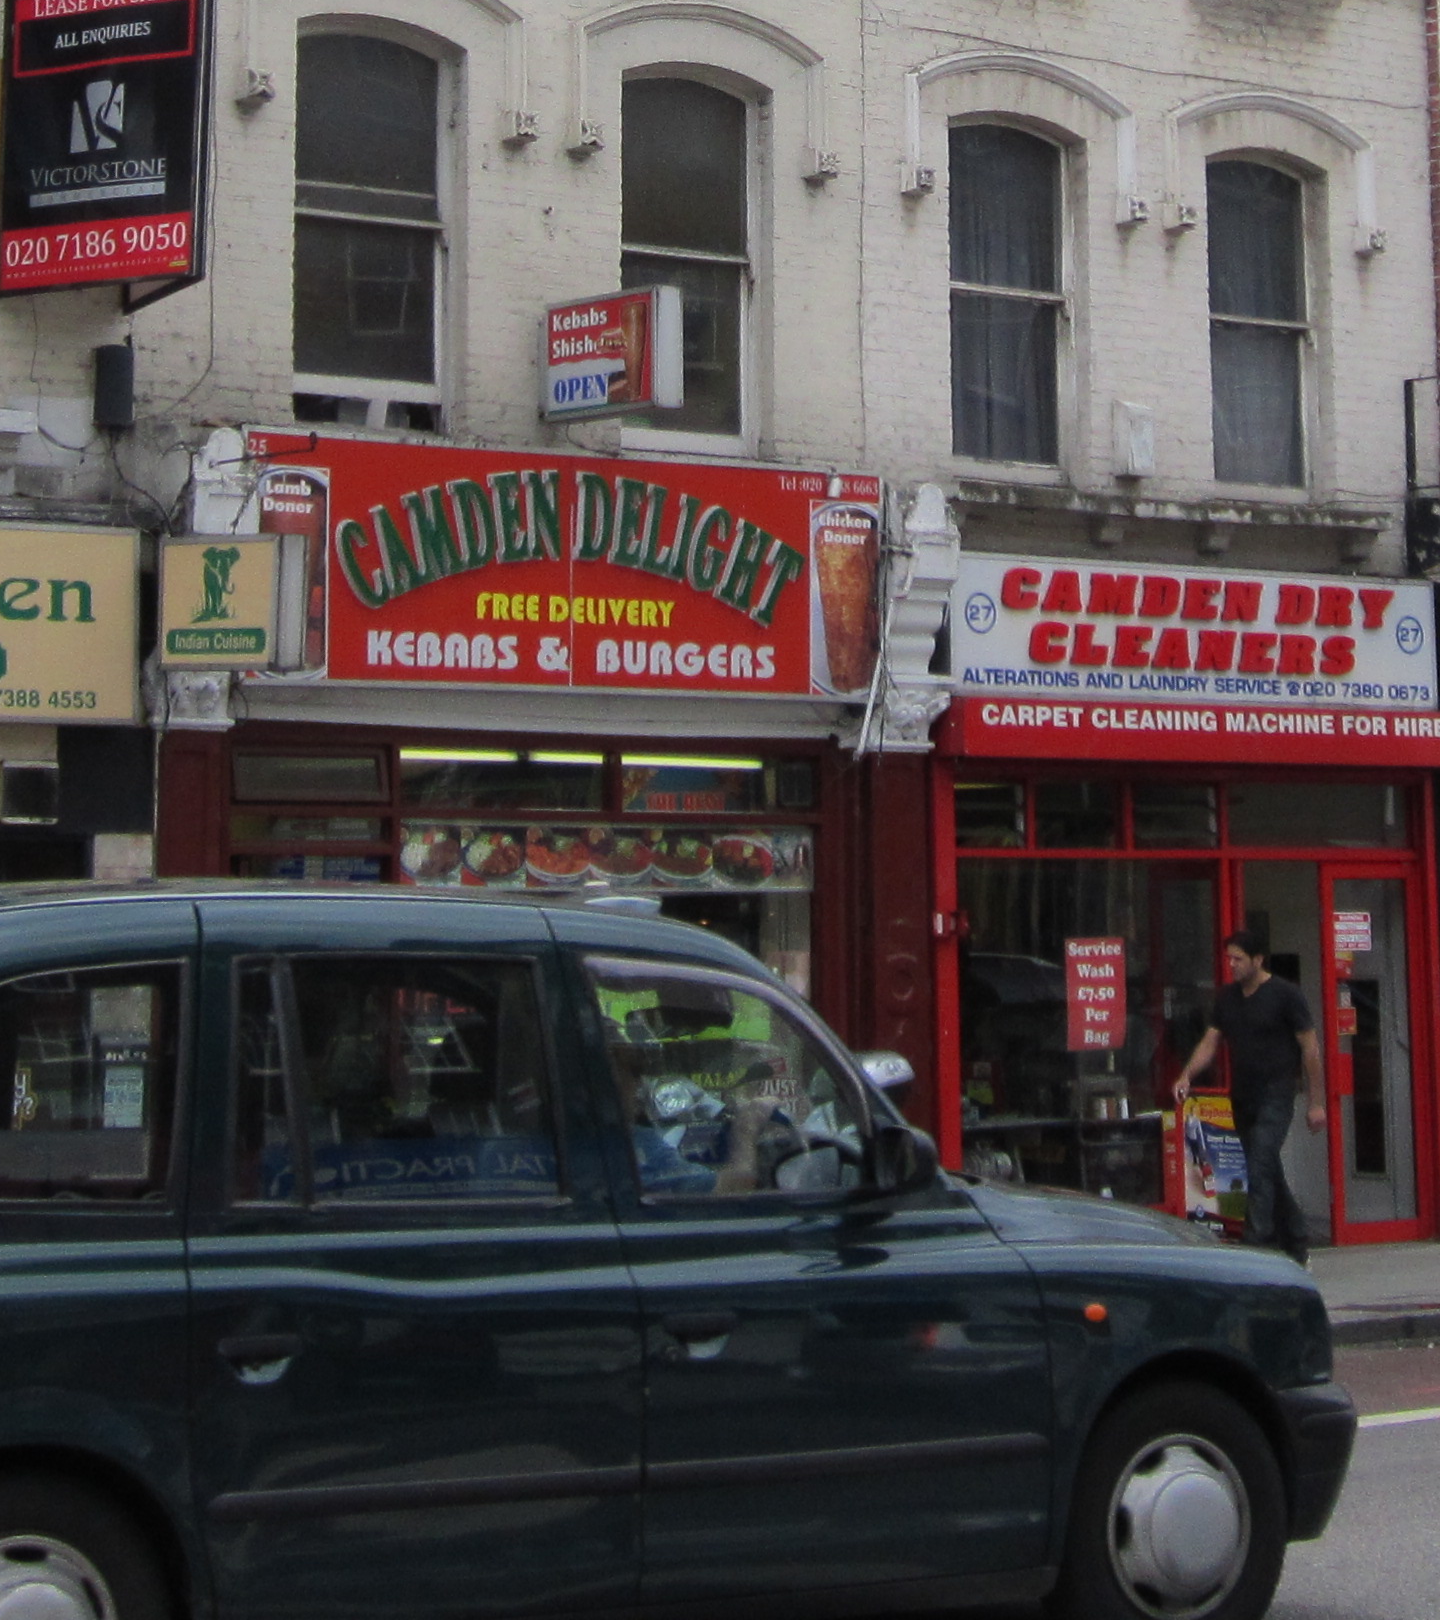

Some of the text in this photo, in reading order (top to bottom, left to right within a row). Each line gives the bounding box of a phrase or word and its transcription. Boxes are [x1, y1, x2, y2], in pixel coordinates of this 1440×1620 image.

[54, 21, 152, 50] ALL ENQUIRIES
[29, 157, 167, 188] VICTORSTONE
[6, 221, 187, 267] 020 7186 9050
[552, 307, 608, 332] Kebabs
[552, 334, 594, 359] Shish
[553, 373, 608, 404] OPEN
[247, 437, 268, 456] 25
[265, 479, 312, 496] Lamb
[262, 497, 314, 515] Doner
[818, 510, 872, 530] Chicken
[823, 530, 866, 545] Doner
[335, 470, 806, 629] CAMDEN DELIGHT
[1000, 567, 1395, 630] CAMDEN DRY
[475, 592, 676, 628] FREE DELIVERY
[968, 603, 992, 622] 27
[174, 632, 258, 651] Indian Cuisine
[1398, 627, 1422, 644] 27
[366, 630, 777, 679] KEBABS & BURGERS
[1028, 621, 1356, 676] CLEANERS
[963, 667, 1430, 700] ALTERATIONS AND LAUNDRY SERVICE 020 7380 0673
[47, 690, 98, 711] 4553
[980, 703, 1084, 729] CARPET
[1091, 710, 1218, 733] CLEANING
[1225, 713, 1336, 736] MACHINE
[1342, 716, 1388, 737] FOR
[1068, 941, 1122, 957] Service
[1076, 963, 1115, 978] Wash
[1077, 986, 1116, 1003] £7.50
[1084, 1007, 1110, 1022] Per
[1084, 1029, 1110, 1047] Bag
